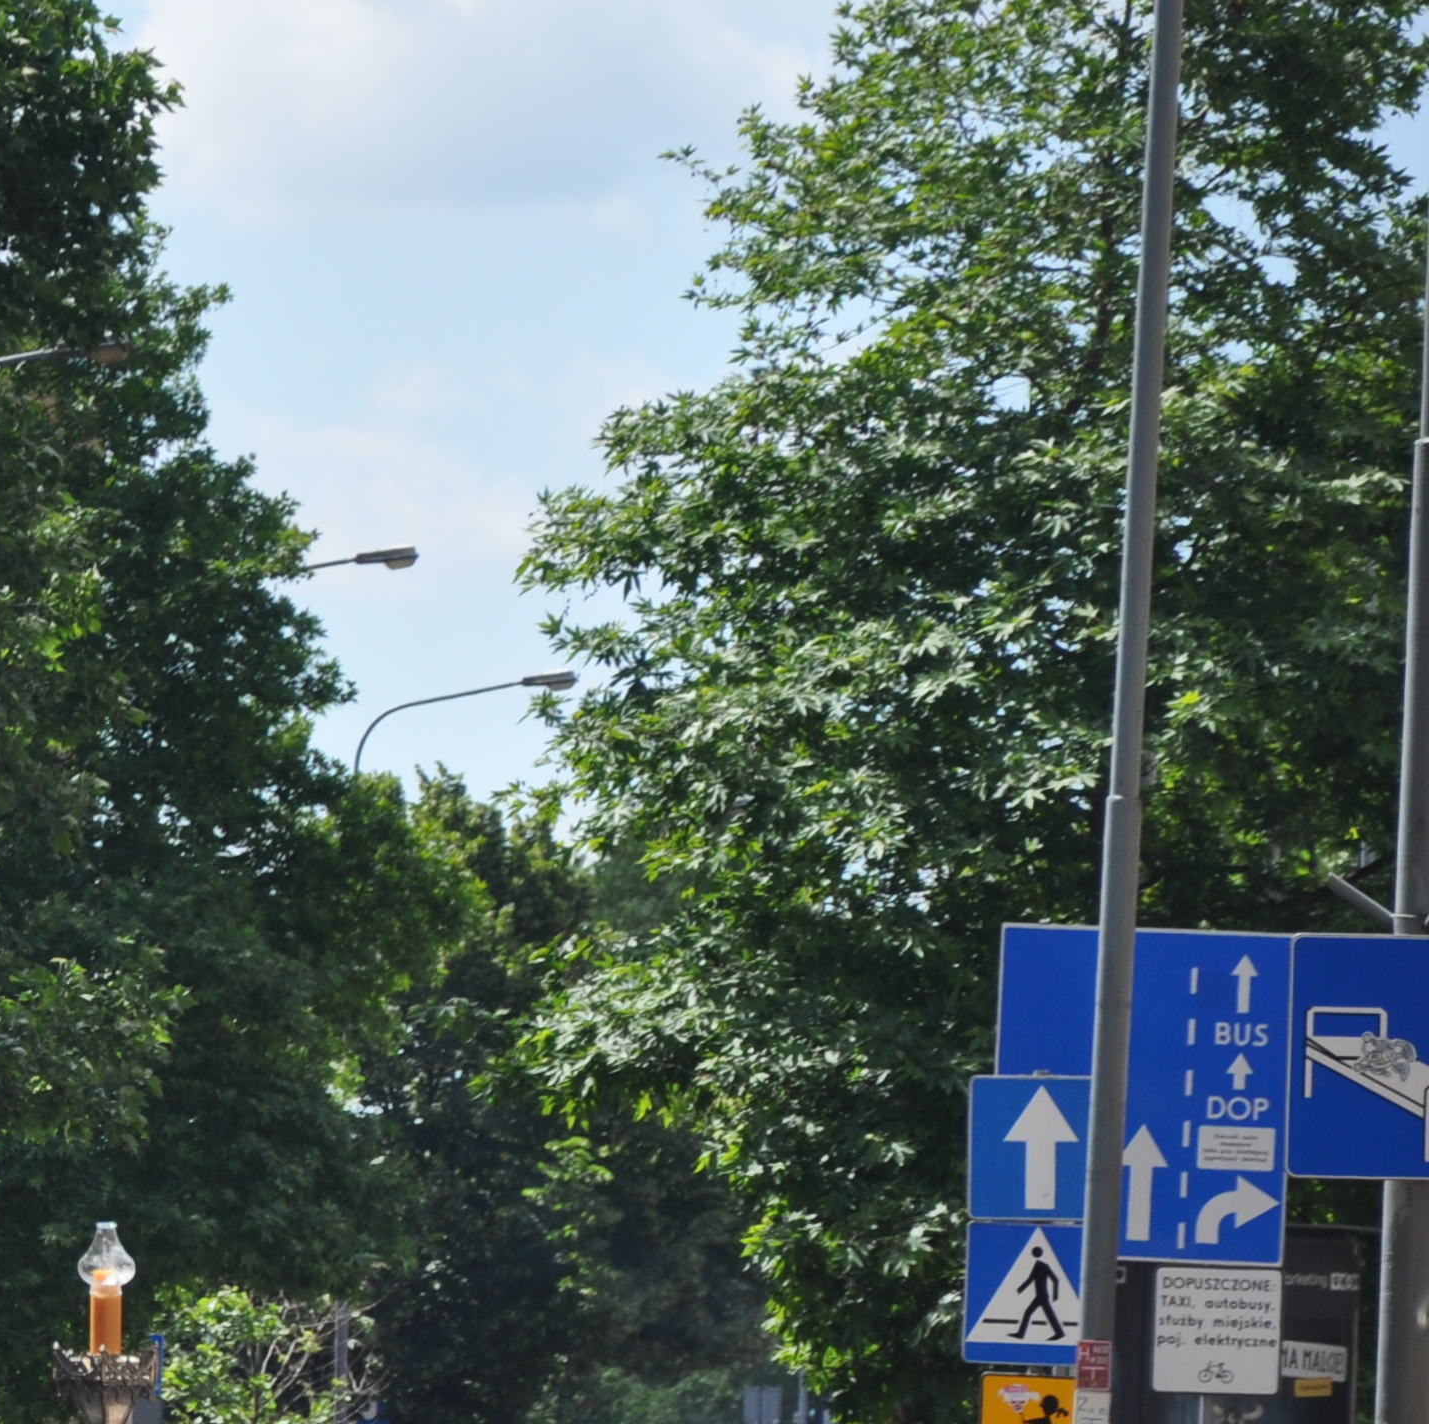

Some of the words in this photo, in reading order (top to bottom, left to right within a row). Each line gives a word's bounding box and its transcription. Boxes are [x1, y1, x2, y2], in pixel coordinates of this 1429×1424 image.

[1215, 1021, 1269, 1047] BUS
[1206, 1096, 1269, 1121] DOP
[1162, 1276, 1277, 1292] DOPUSZCZONE:
[1159, 1315, 1203, 1330] służby
[1194, 1333, 1277, 1350] elektryczne
